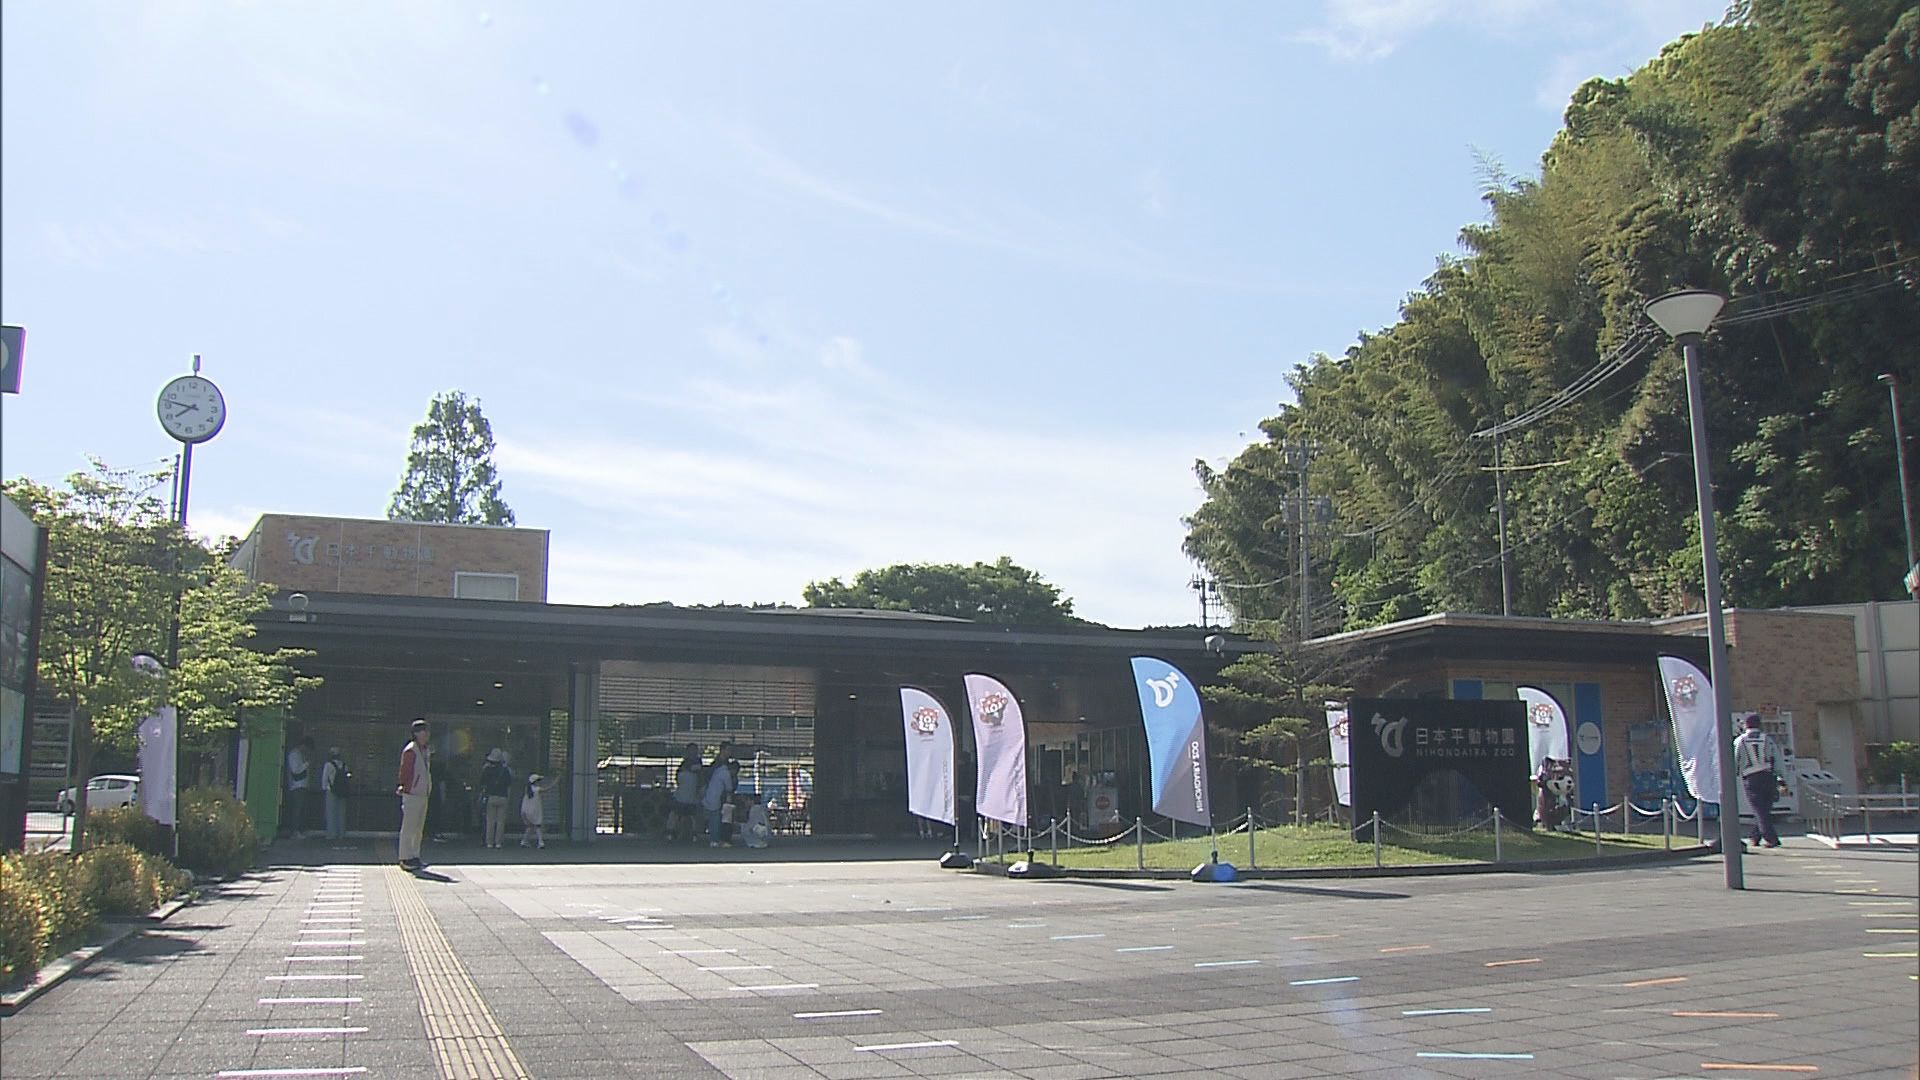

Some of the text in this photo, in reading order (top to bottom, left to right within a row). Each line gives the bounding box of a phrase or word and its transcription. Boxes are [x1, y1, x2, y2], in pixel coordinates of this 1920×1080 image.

[1416, 727, 1515, 745] 日本平動物園
[1416, 748, 1515, 757] NIHONDAIRA ZOO
